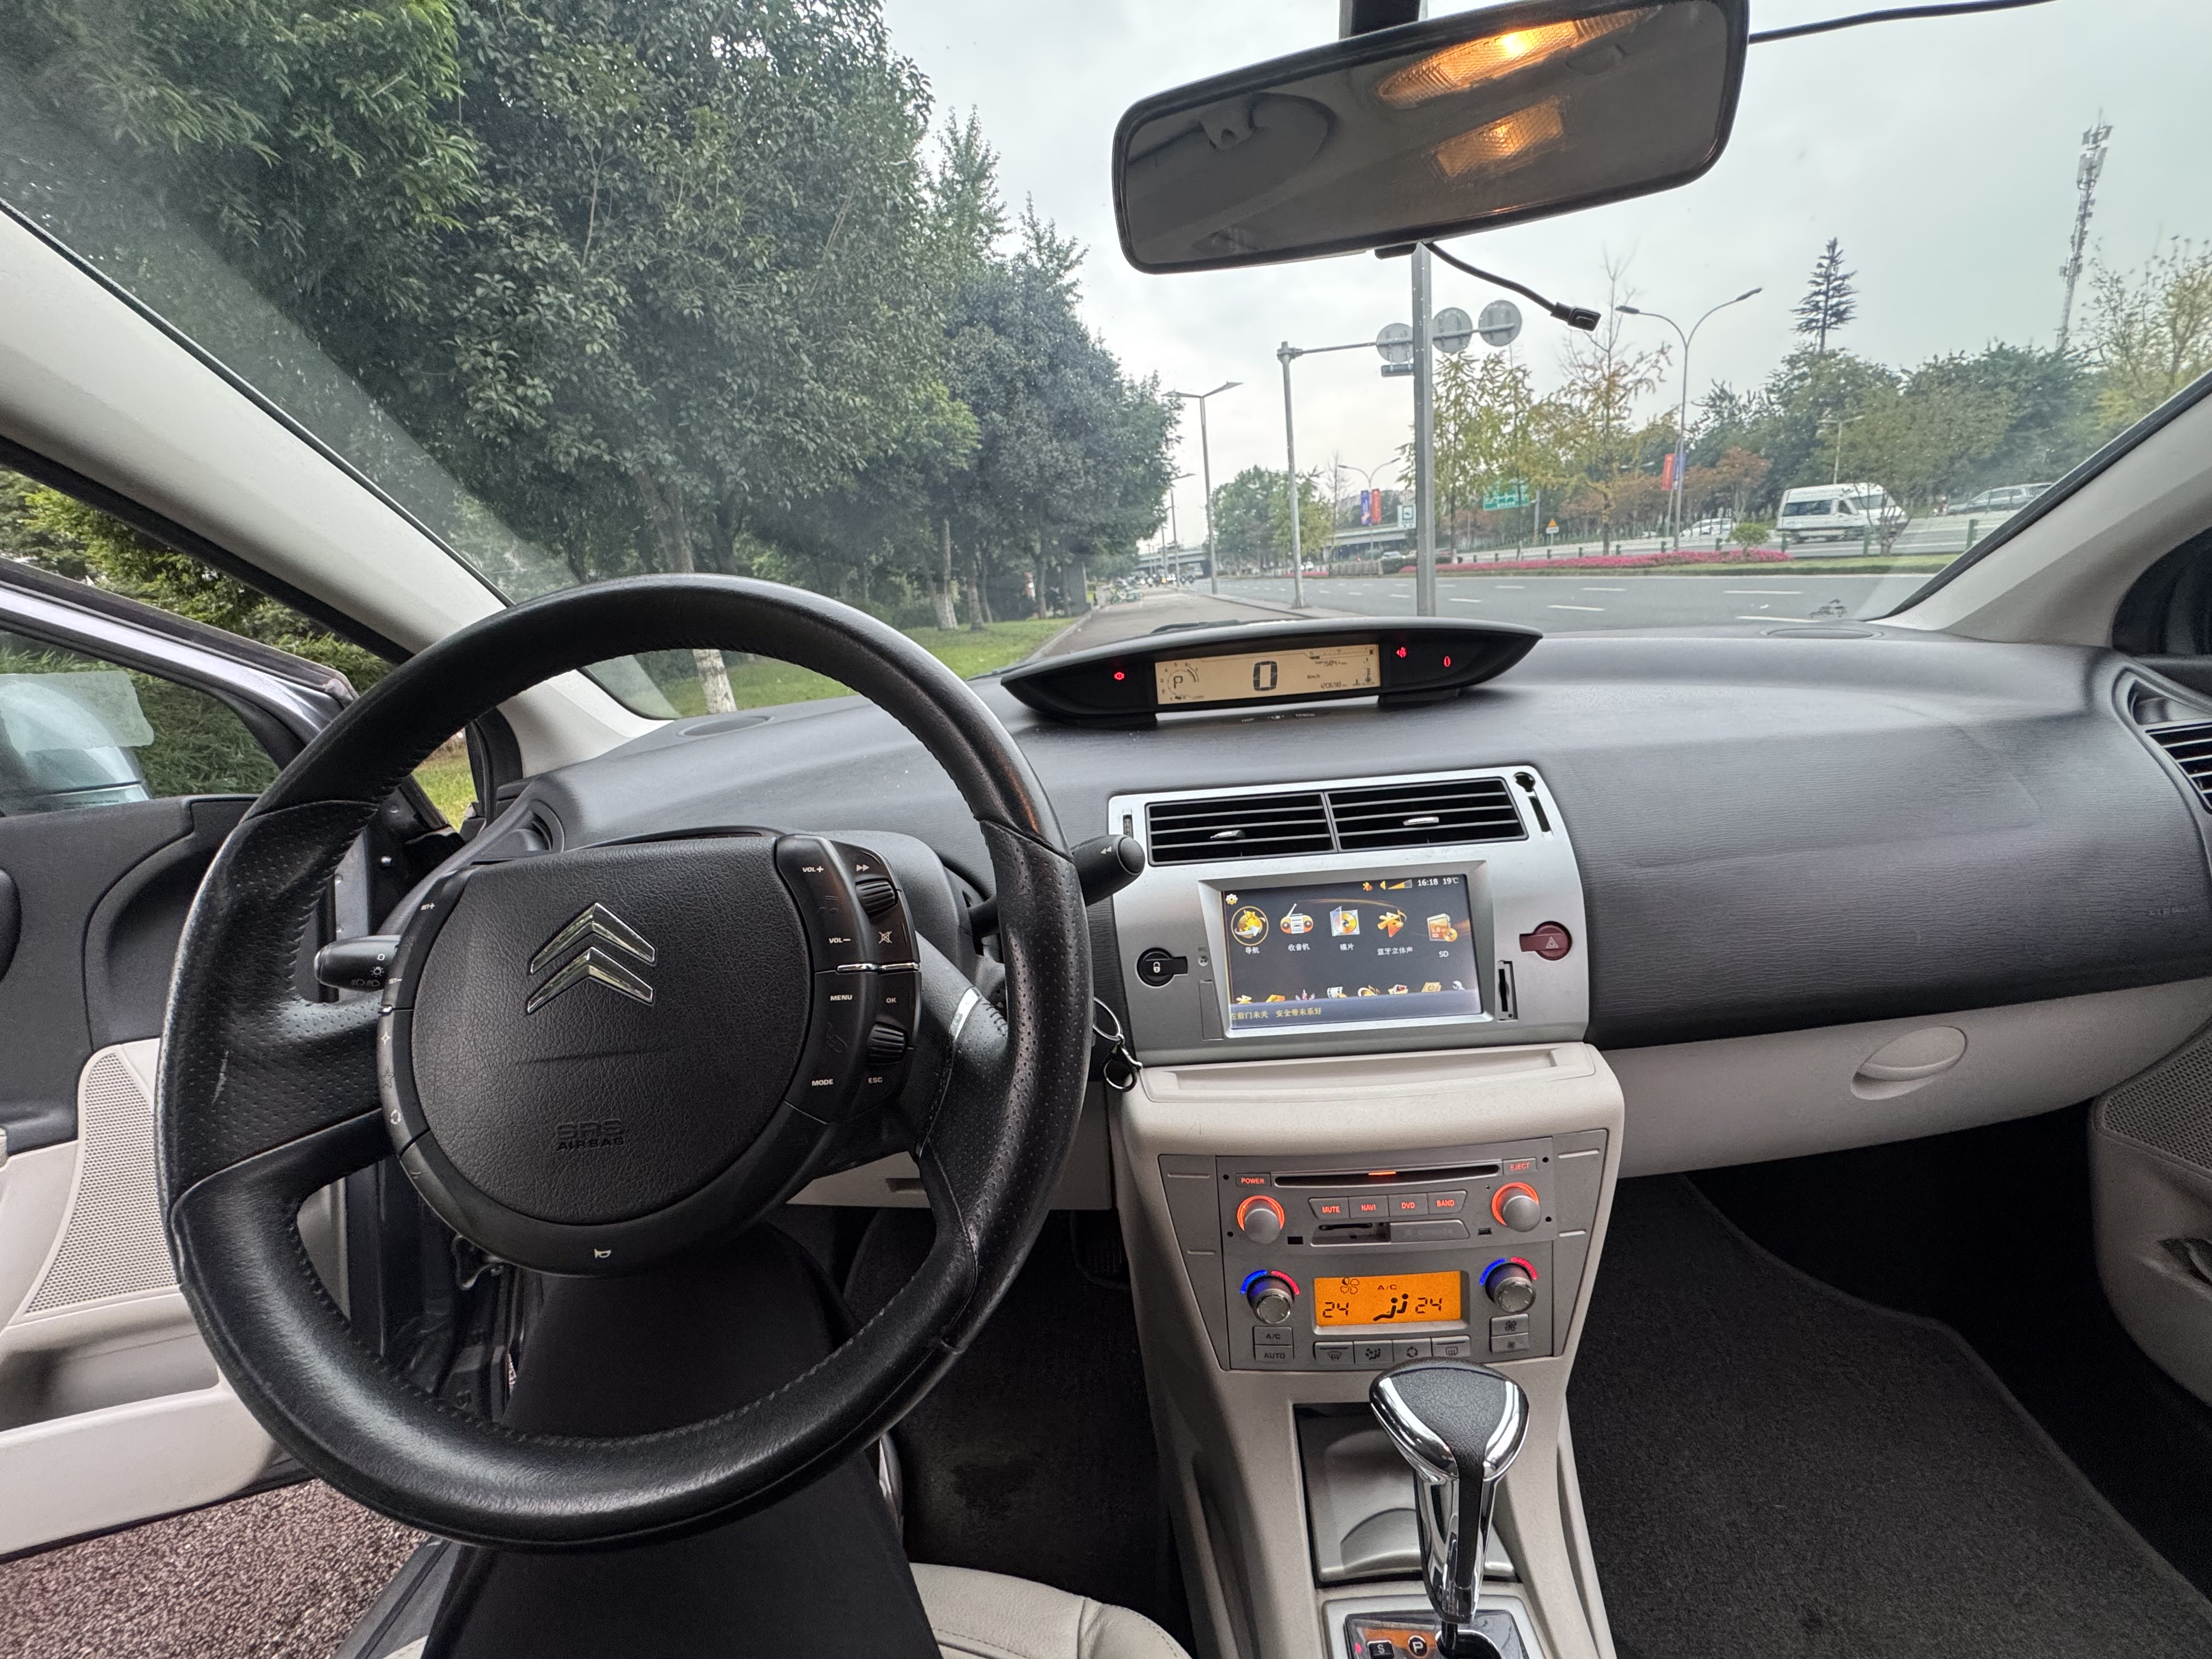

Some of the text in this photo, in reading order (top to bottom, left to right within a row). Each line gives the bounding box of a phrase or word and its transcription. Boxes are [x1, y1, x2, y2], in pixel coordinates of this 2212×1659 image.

[1253, 661, 1278, 691] 0
[1173, 675, 1183, 689] P
[1418, 878, 1438, 887] 16:18
[1288, 943, 1311, 951] 收音机
[556, 1137, 624, 1151] AIRBAG
[1510, 1162, 1531, 1171] EJECT
[1322, 1205, 1340, 1214] MUTE
[1323, 1297, 1442, 1318] 24 24
[1377, 1644, 1385, 1654] S
[1413, 1641, 1424, 1653] P
